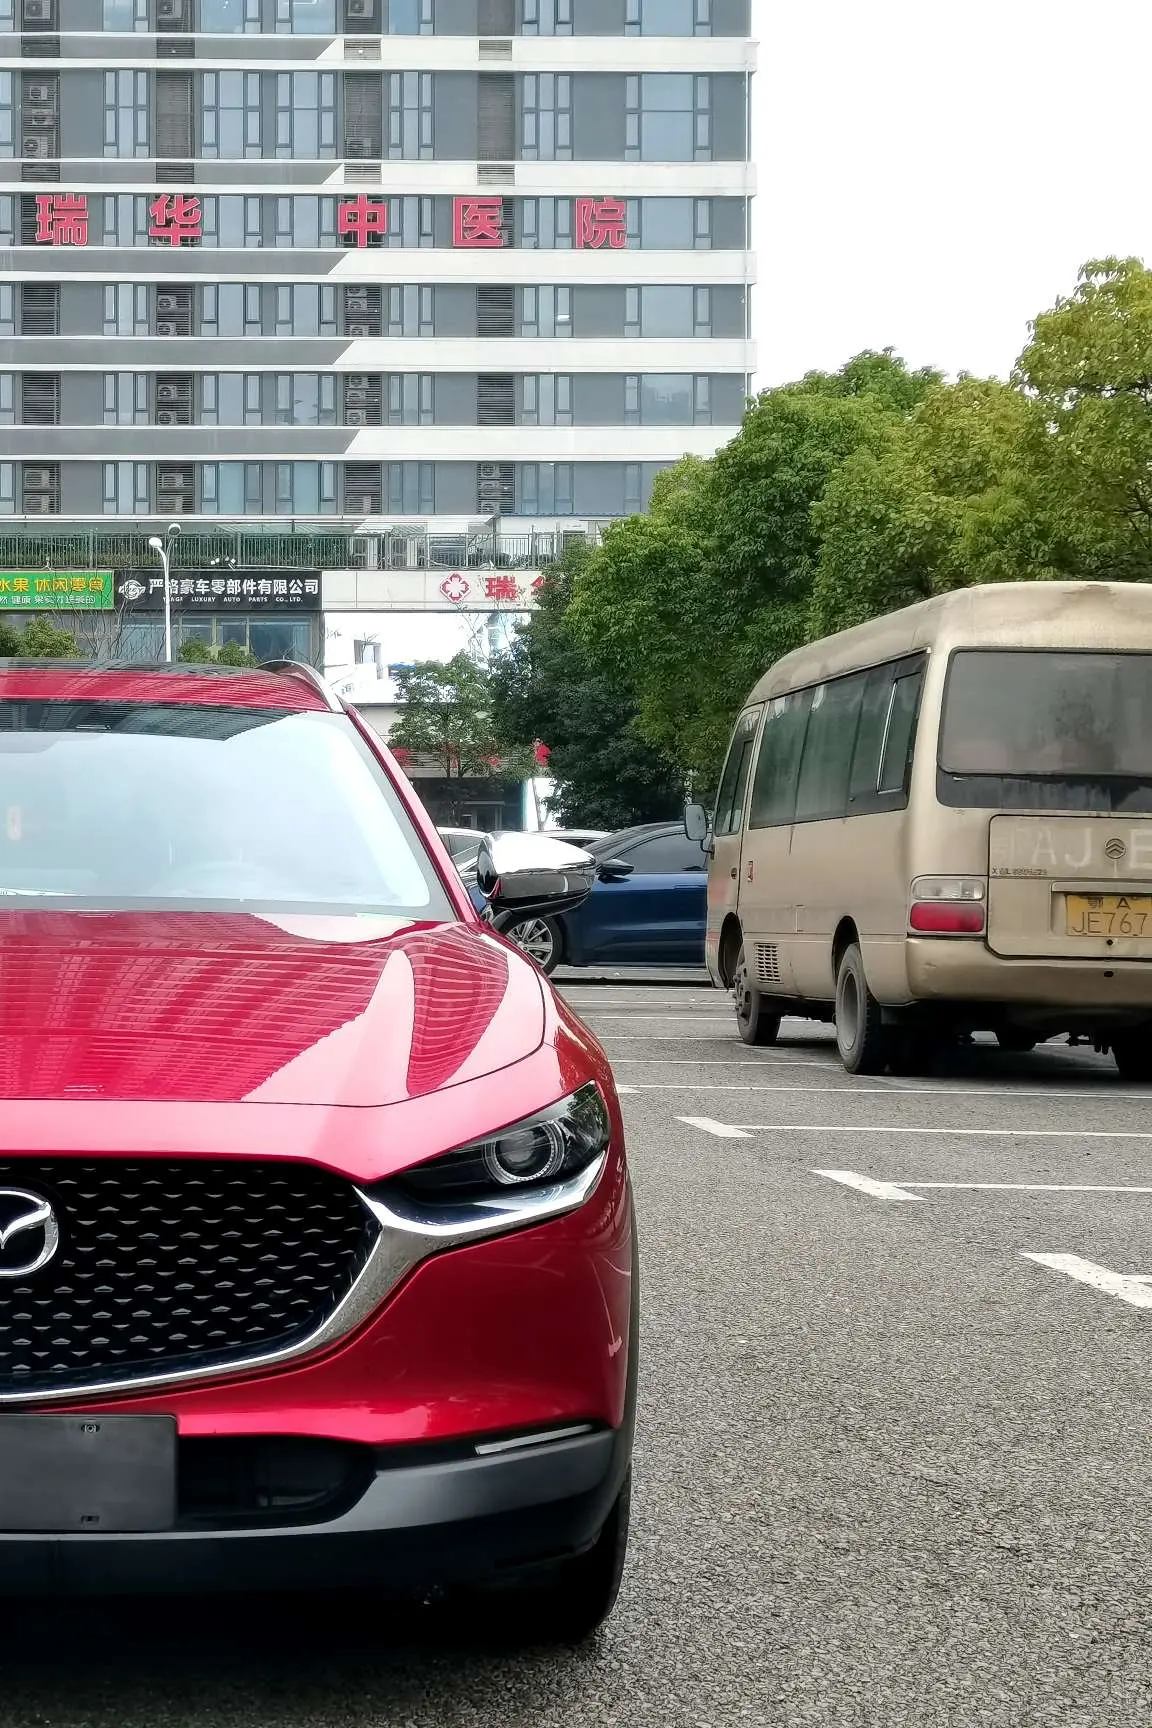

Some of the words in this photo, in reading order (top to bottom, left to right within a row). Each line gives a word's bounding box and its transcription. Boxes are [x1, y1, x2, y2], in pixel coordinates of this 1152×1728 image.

[35, 192, 626, 249] 瑞华中医院
[1072, 911, 1148, 935] JE767
